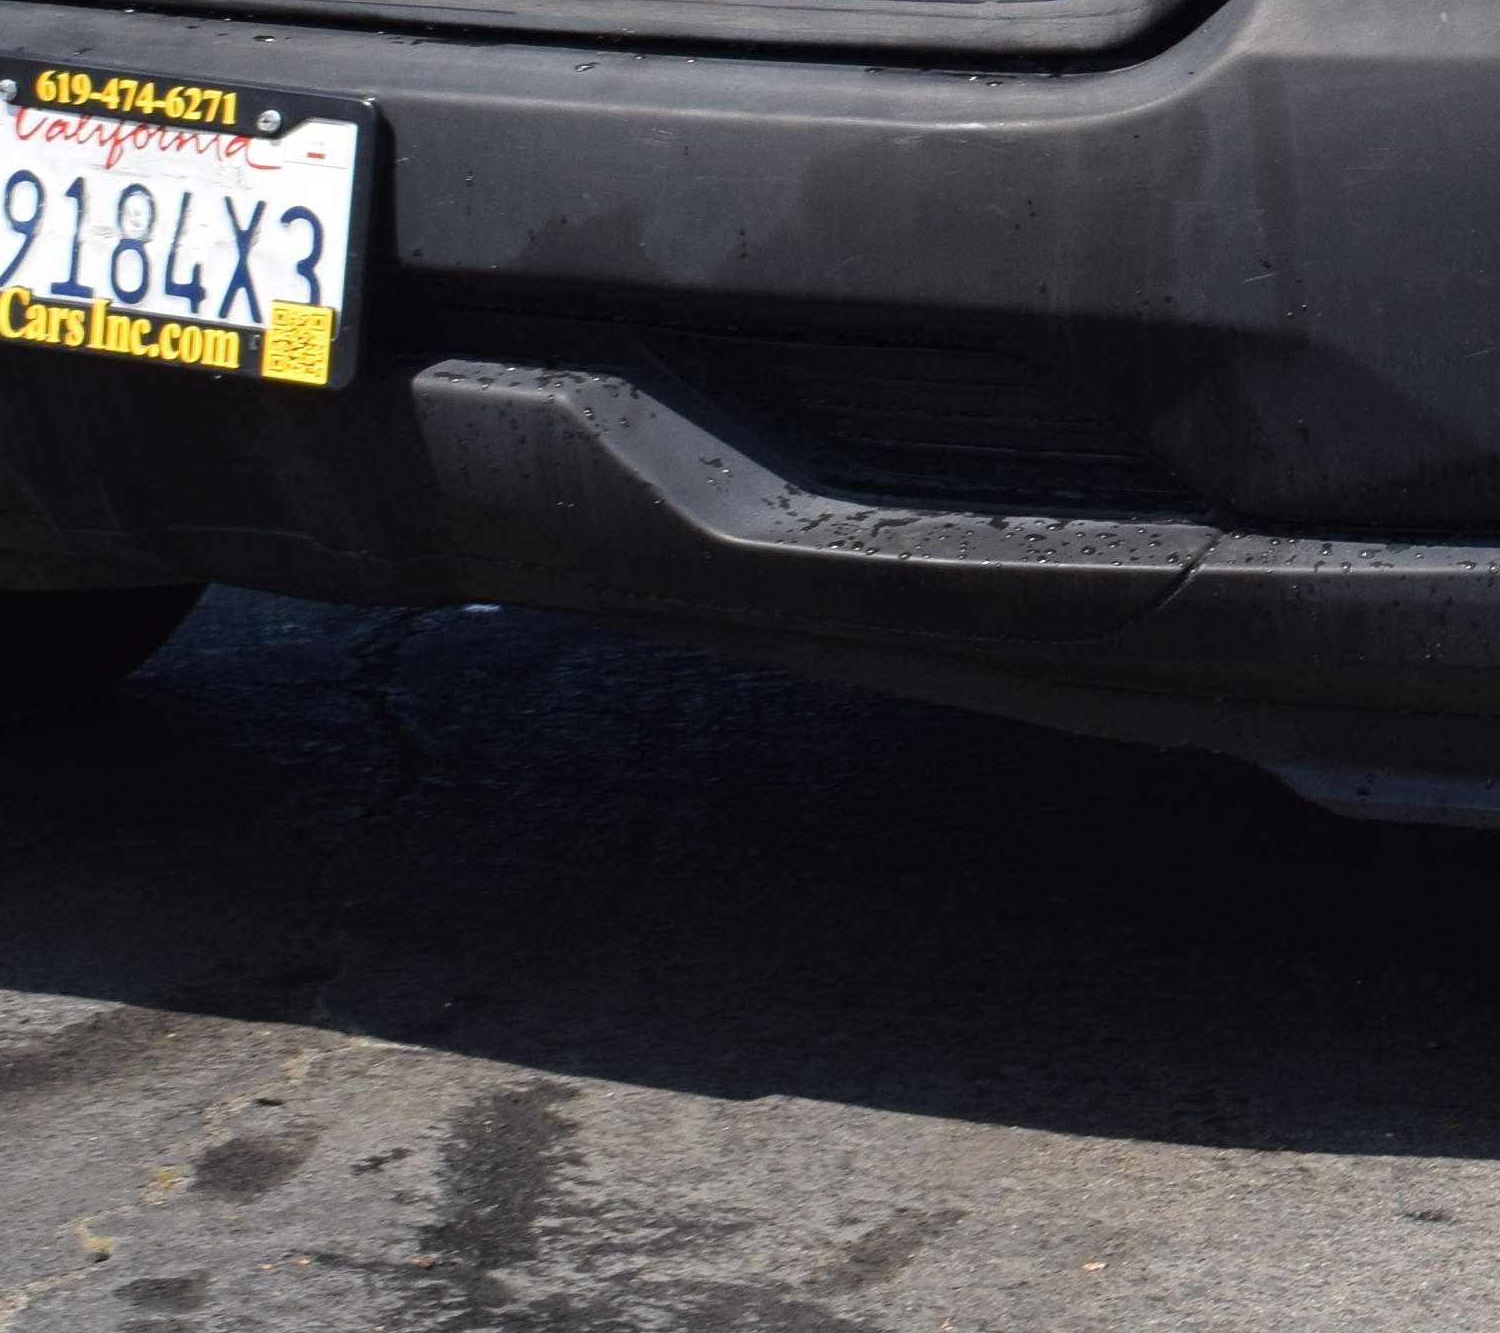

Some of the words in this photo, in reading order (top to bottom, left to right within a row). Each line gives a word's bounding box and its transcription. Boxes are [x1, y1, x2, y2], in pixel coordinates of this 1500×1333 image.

[35, 69, 238, 125] 619-474-6271
[14, 105, 282, 170] California
[86, 298, 242, 369] Inc.com
